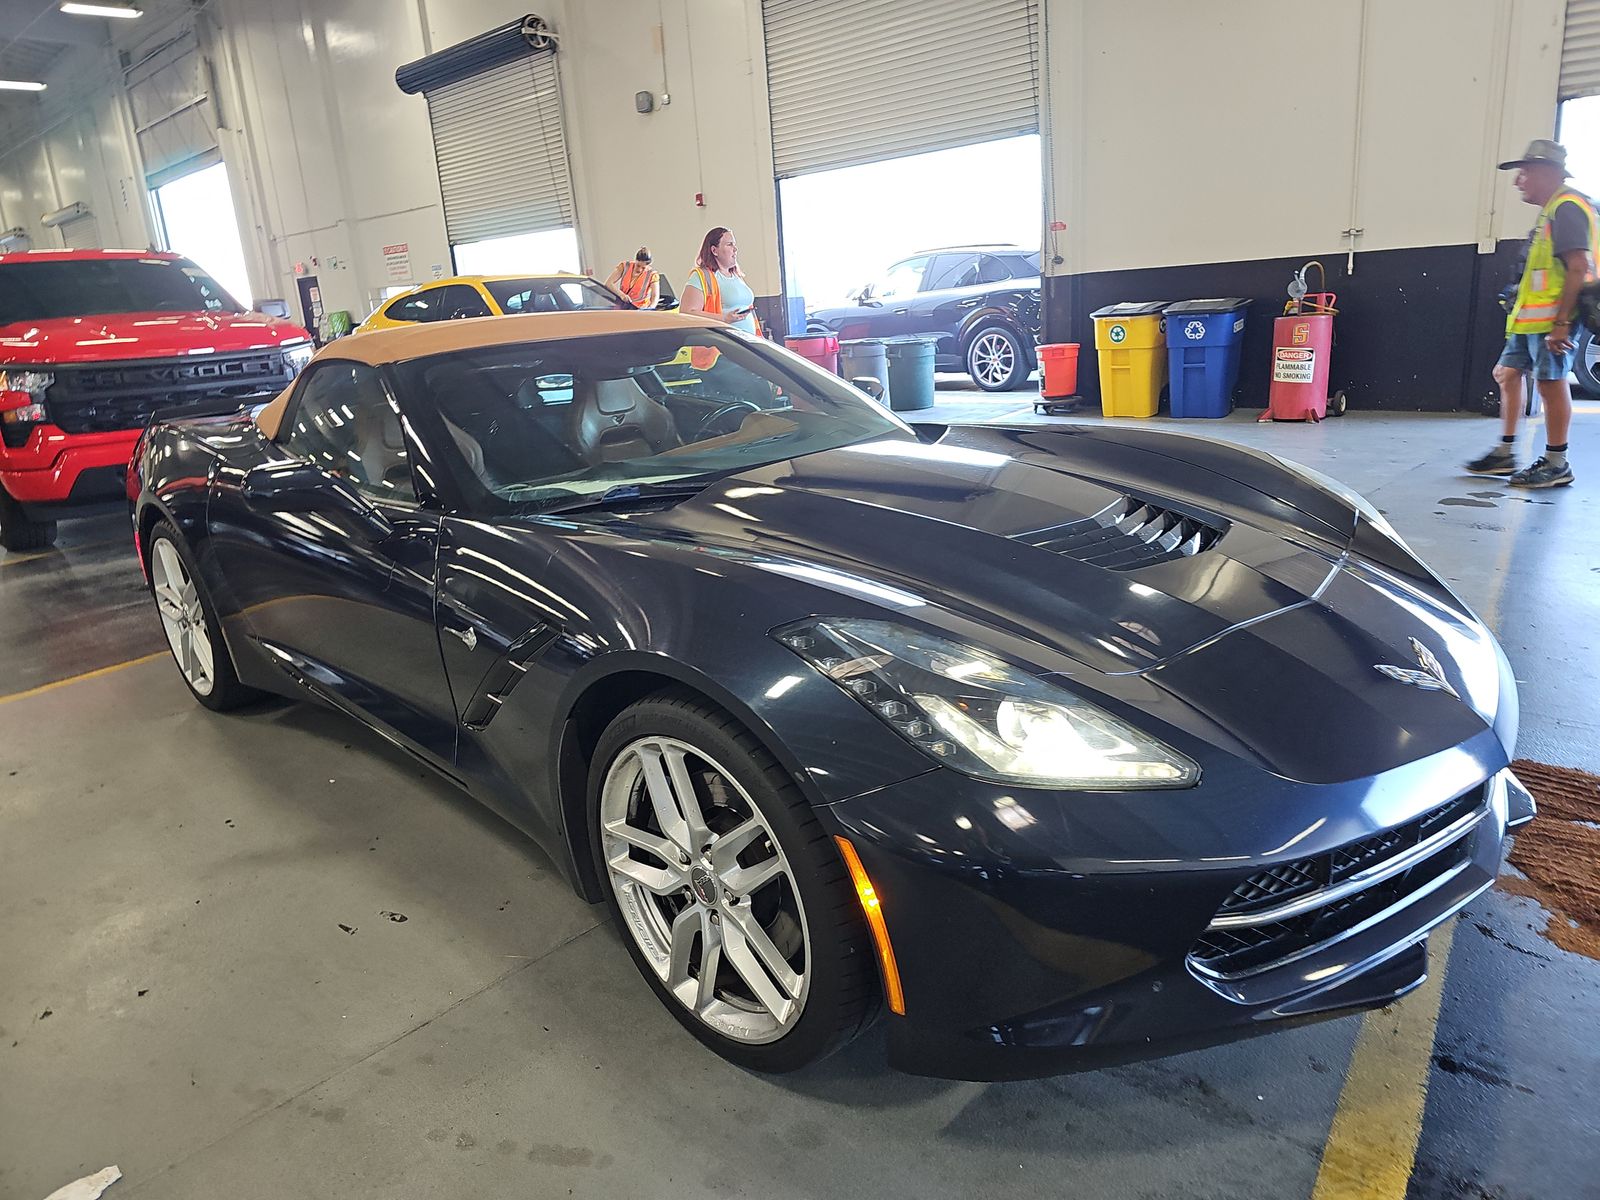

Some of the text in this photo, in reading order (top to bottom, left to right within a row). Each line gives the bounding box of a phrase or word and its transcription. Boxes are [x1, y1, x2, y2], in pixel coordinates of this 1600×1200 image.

[1292, 323, 1310, 345] S
[1280, 351, 1310, 359] DANGER
[1283, 372, 1311, 380] SMOKING
